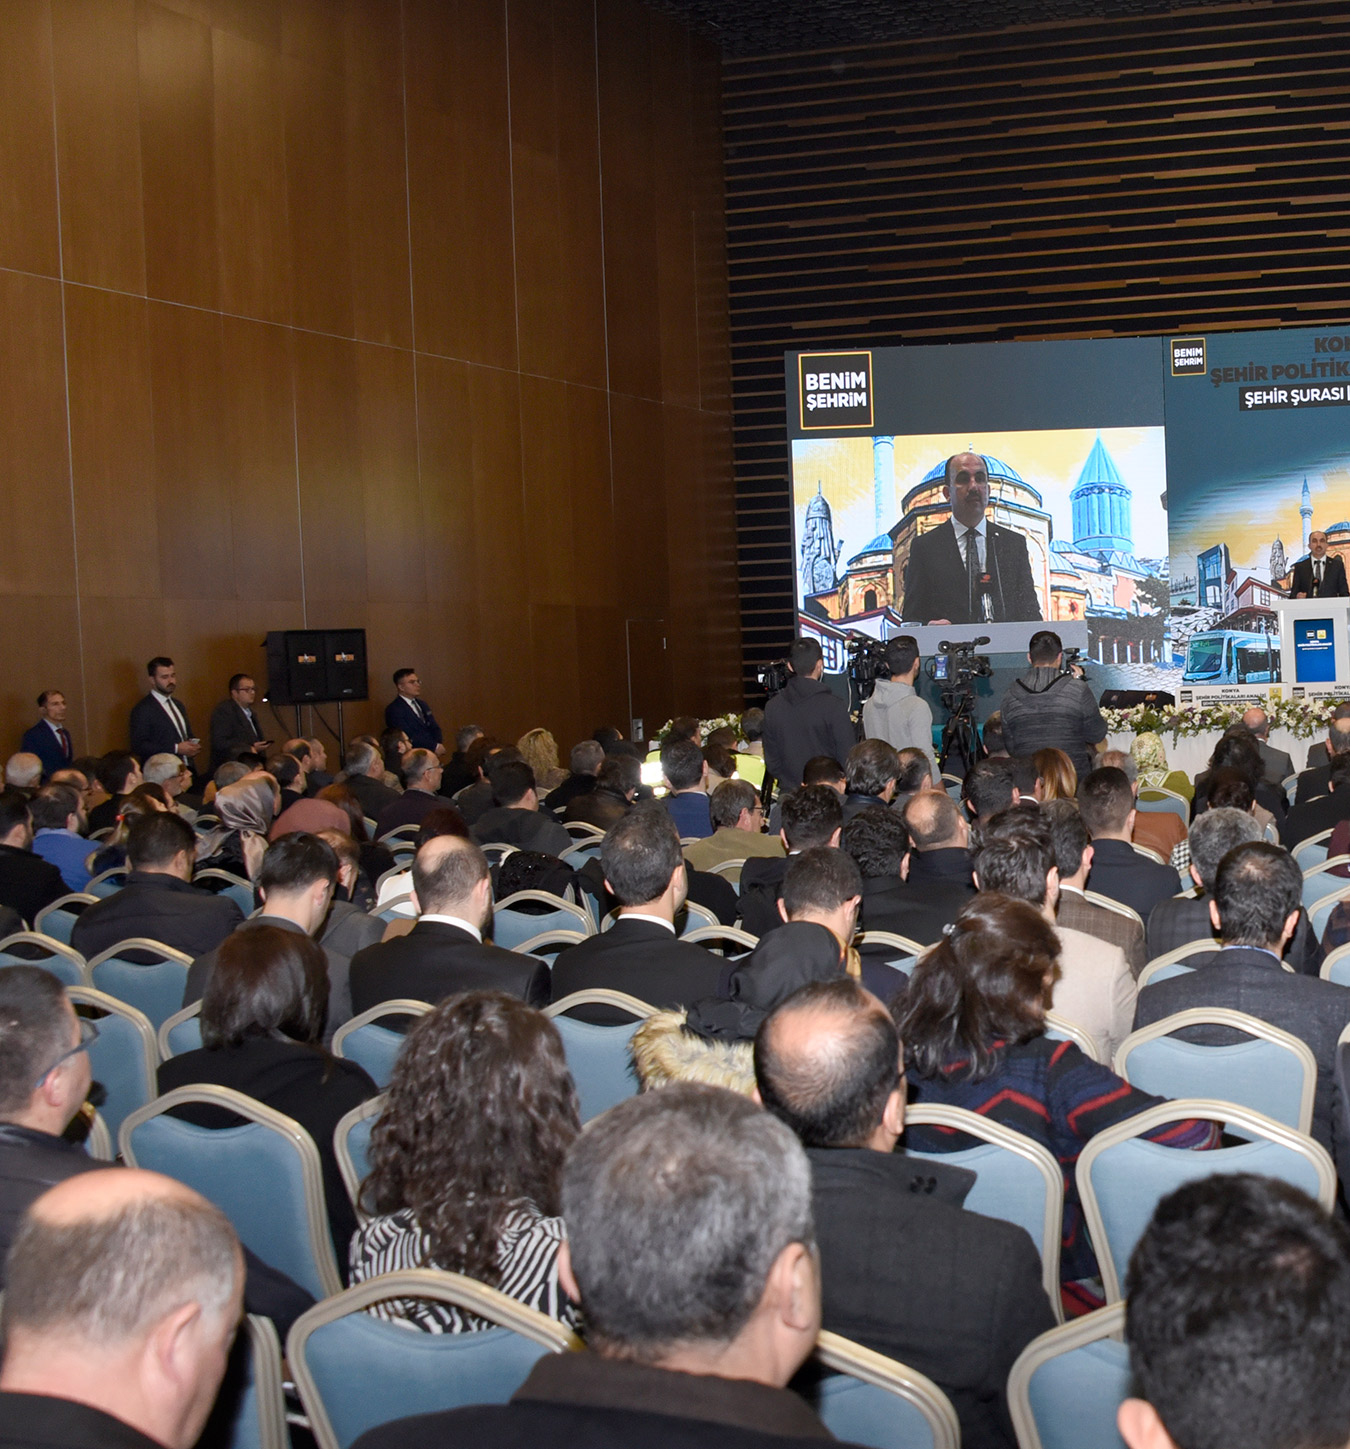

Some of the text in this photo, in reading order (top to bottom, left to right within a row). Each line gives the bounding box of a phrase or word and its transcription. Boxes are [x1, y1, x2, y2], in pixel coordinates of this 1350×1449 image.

[1210, 361, 1268, 388] ŞEHİR
[1244, 387, 1289, 409] ŞEHİR
[1290, 386, 1345, 406] ŞURASI
